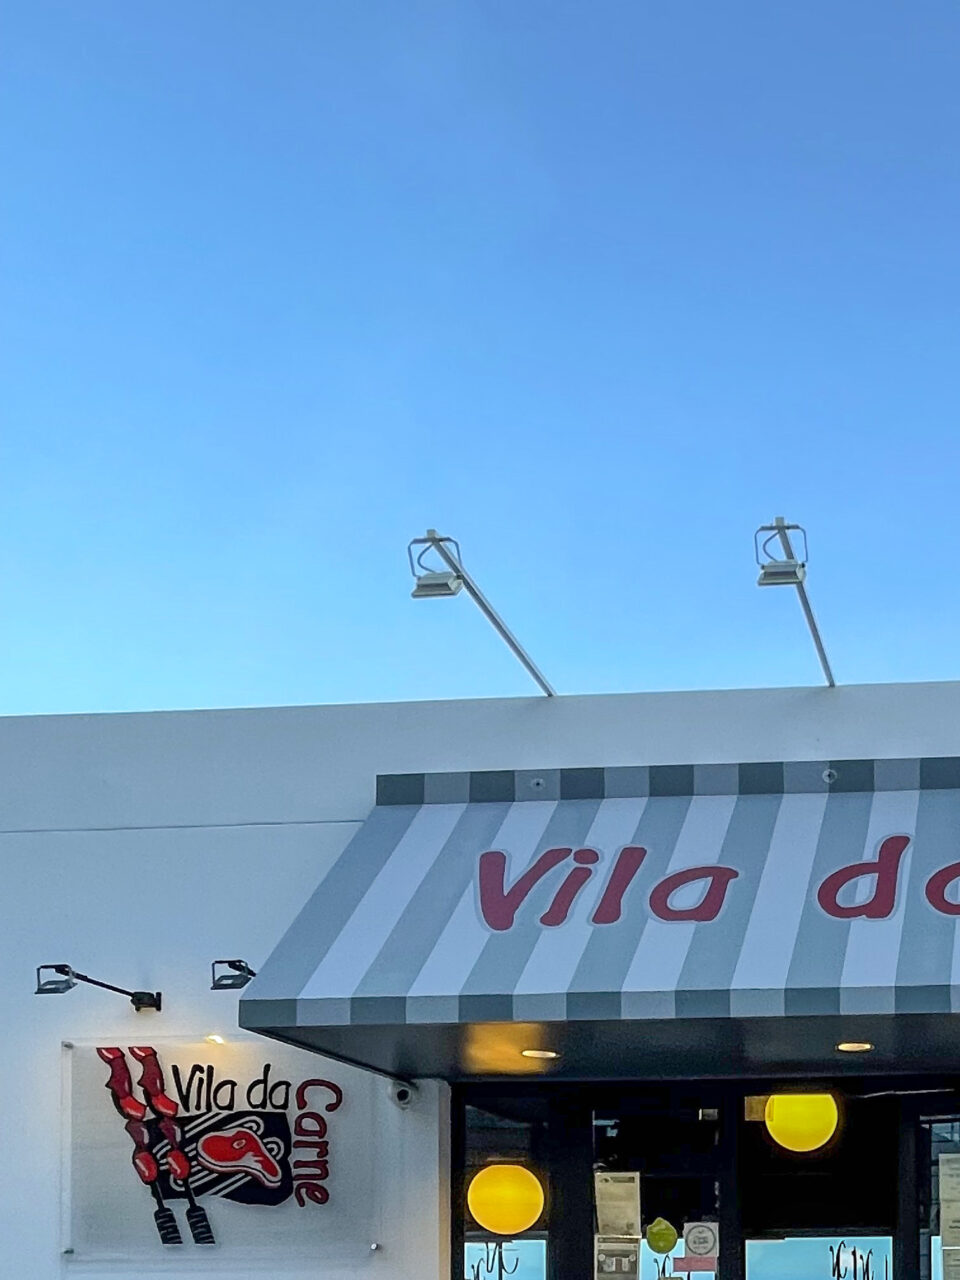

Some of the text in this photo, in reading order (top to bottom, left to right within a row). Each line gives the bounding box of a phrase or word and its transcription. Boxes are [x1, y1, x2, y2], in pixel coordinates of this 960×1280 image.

[478, 846, 738, 931] Vila
[171, 1063, 291, 1111] Vila da
[293, 1078, 343, 1208] Carne
